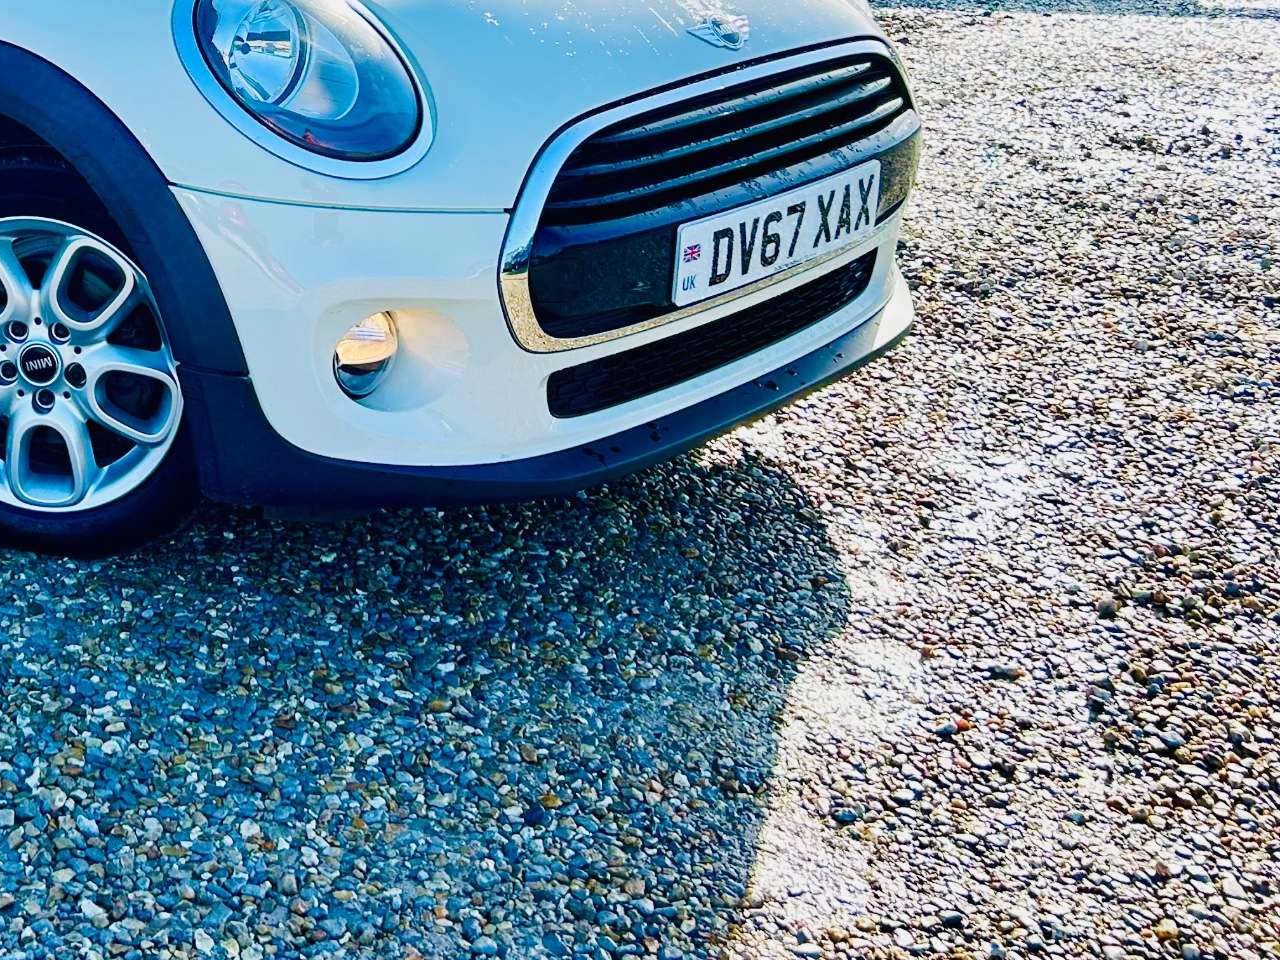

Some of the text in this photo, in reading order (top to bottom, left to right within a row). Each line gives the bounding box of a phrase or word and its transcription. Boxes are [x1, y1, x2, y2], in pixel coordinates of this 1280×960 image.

[708, 173, 875, 287] DV67 XAX
[682, 275, 696, 291] UK
[25, 356, 53, 372] MINI
